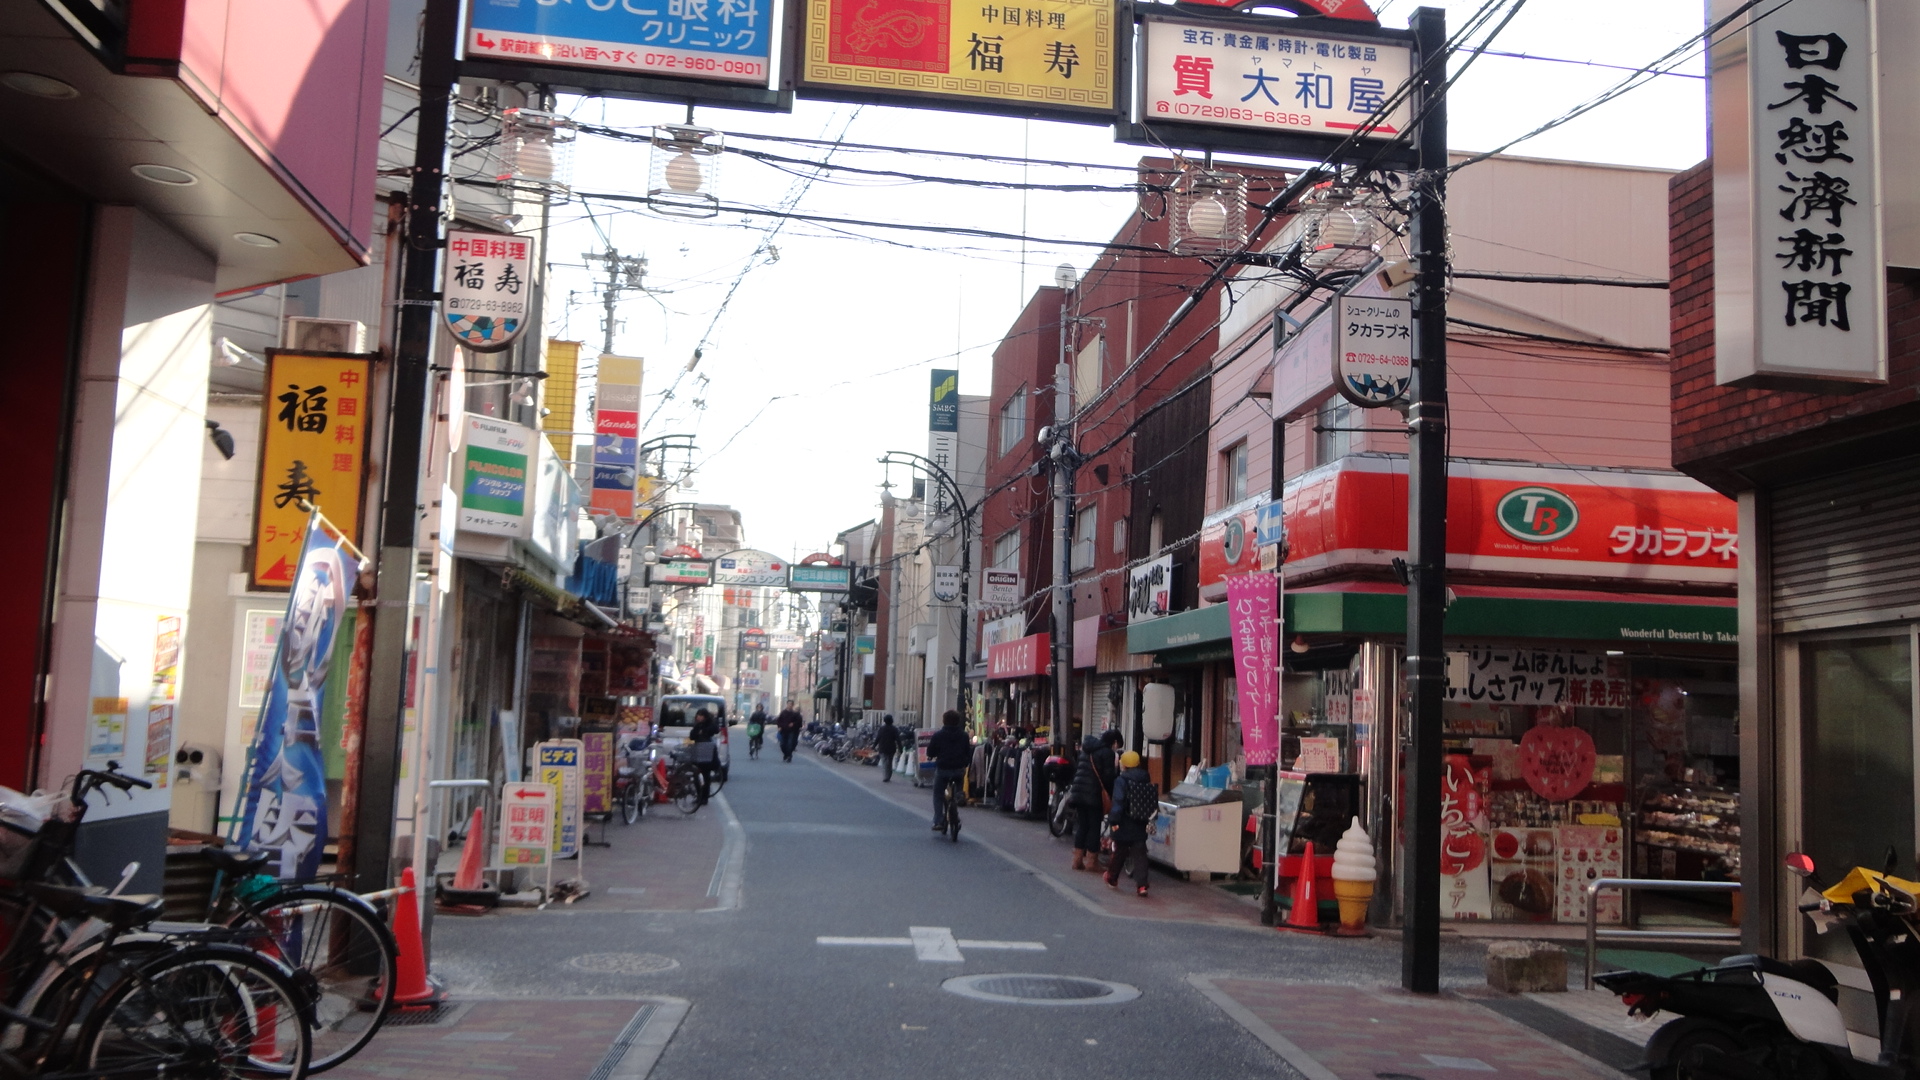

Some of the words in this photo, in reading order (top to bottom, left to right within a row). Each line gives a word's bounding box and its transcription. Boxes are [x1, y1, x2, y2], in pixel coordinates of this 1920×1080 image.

[982, 4, 1066, 30] 中国料理
[642, 20, 756, 50] クリニック
[500, 38, 638, 64] 駅前線沿い西へすぐ
[645, 53, 762, 76] 072-960-0901
[1173, 55, 1214, 99] 質
[1240, 67, 1386, 116] 大和屋
[1174, 102, 1312, 127] (0729)63-6363
[452, 238, 526, 260] 中国料理
[460, 298, 524, 313] 0729-63-8962
[1347, 306, 1400, 318] シュークリームの
[1347, 322, 1410, 339] タカラブネ
[932, 403, 956, 414] SMBC
[332, 369, 360, 472] 中国料理
[598, 418, 637, 430] Kanebo
[480, 423, 508, 435] FUJIFILM
[468, 460, 524, 479] FUJICOLOR
[933, 437, 950, 514] 三井友銀
[489, 488, 511, 497] ショップ
[265, 526, 304, 543] ラーメ
[1493, 542, 1520, 550] Wonderful
[1608, 525, 1738, 561] タカラブネ
[716, 573, 757, 583] フレッシュ
[760, 576, 786, 584] シンワ
[989, 575, 1016, 583] ORIGIN
[992, 584, 1013, 593] Bento
[991, 594, 1013, 602] Delica
[1620, 628, 1665, 639] Wonderful
[1668, 629, 1700, 641] Dessert
[1703, 630, 1714, 642] by
[1569, 679, 1626, 707] 新発売
[541, 750, 576, 763] ビデオ
[511, 807, 545, 823] 証明
[510, 826, 545, 842] 写真
[1774, 990, 1802, 1001] GEAR
